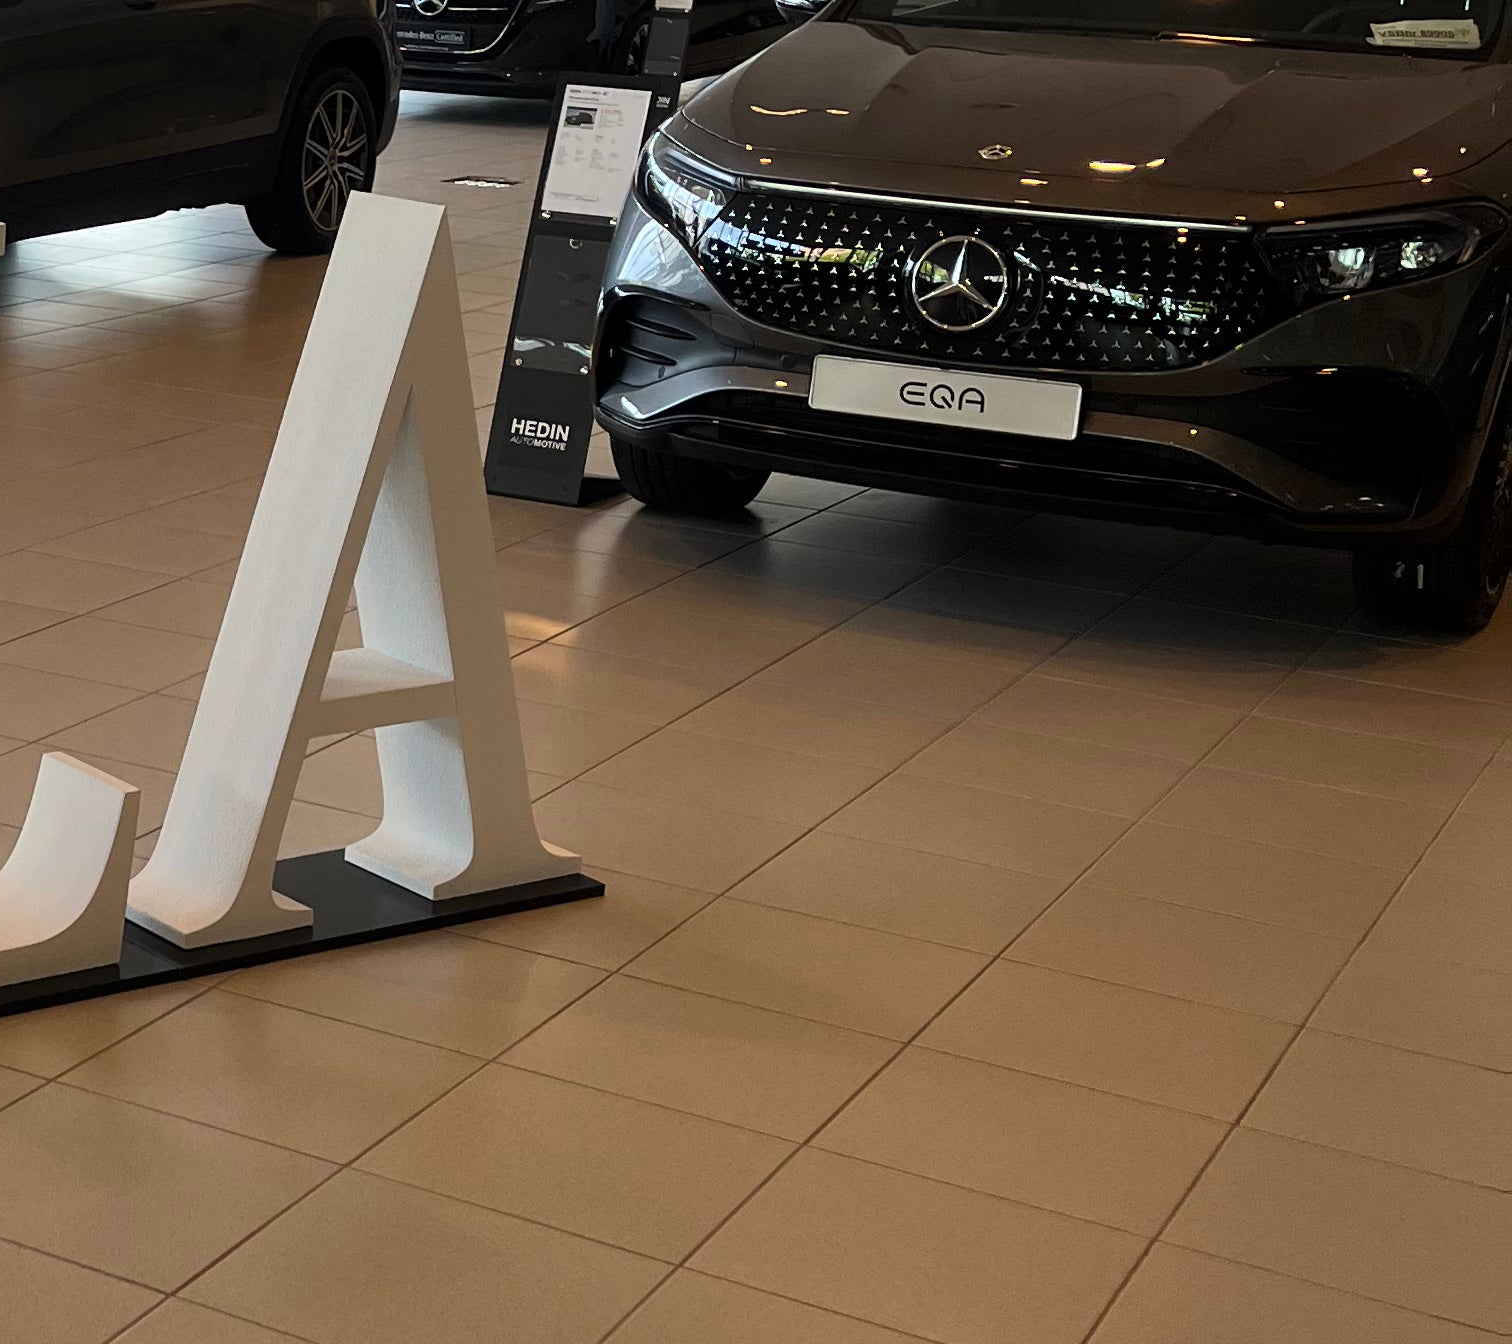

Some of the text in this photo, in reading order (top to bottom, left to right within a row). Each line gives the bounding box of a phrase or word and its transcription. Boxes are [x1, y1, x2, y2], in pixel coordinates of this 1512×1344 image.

[899, 381, 985, 413] EQA
[511, 418, 570, 442] HEDIN
[510, 436, 567, 451] AUTOMOTIVE
